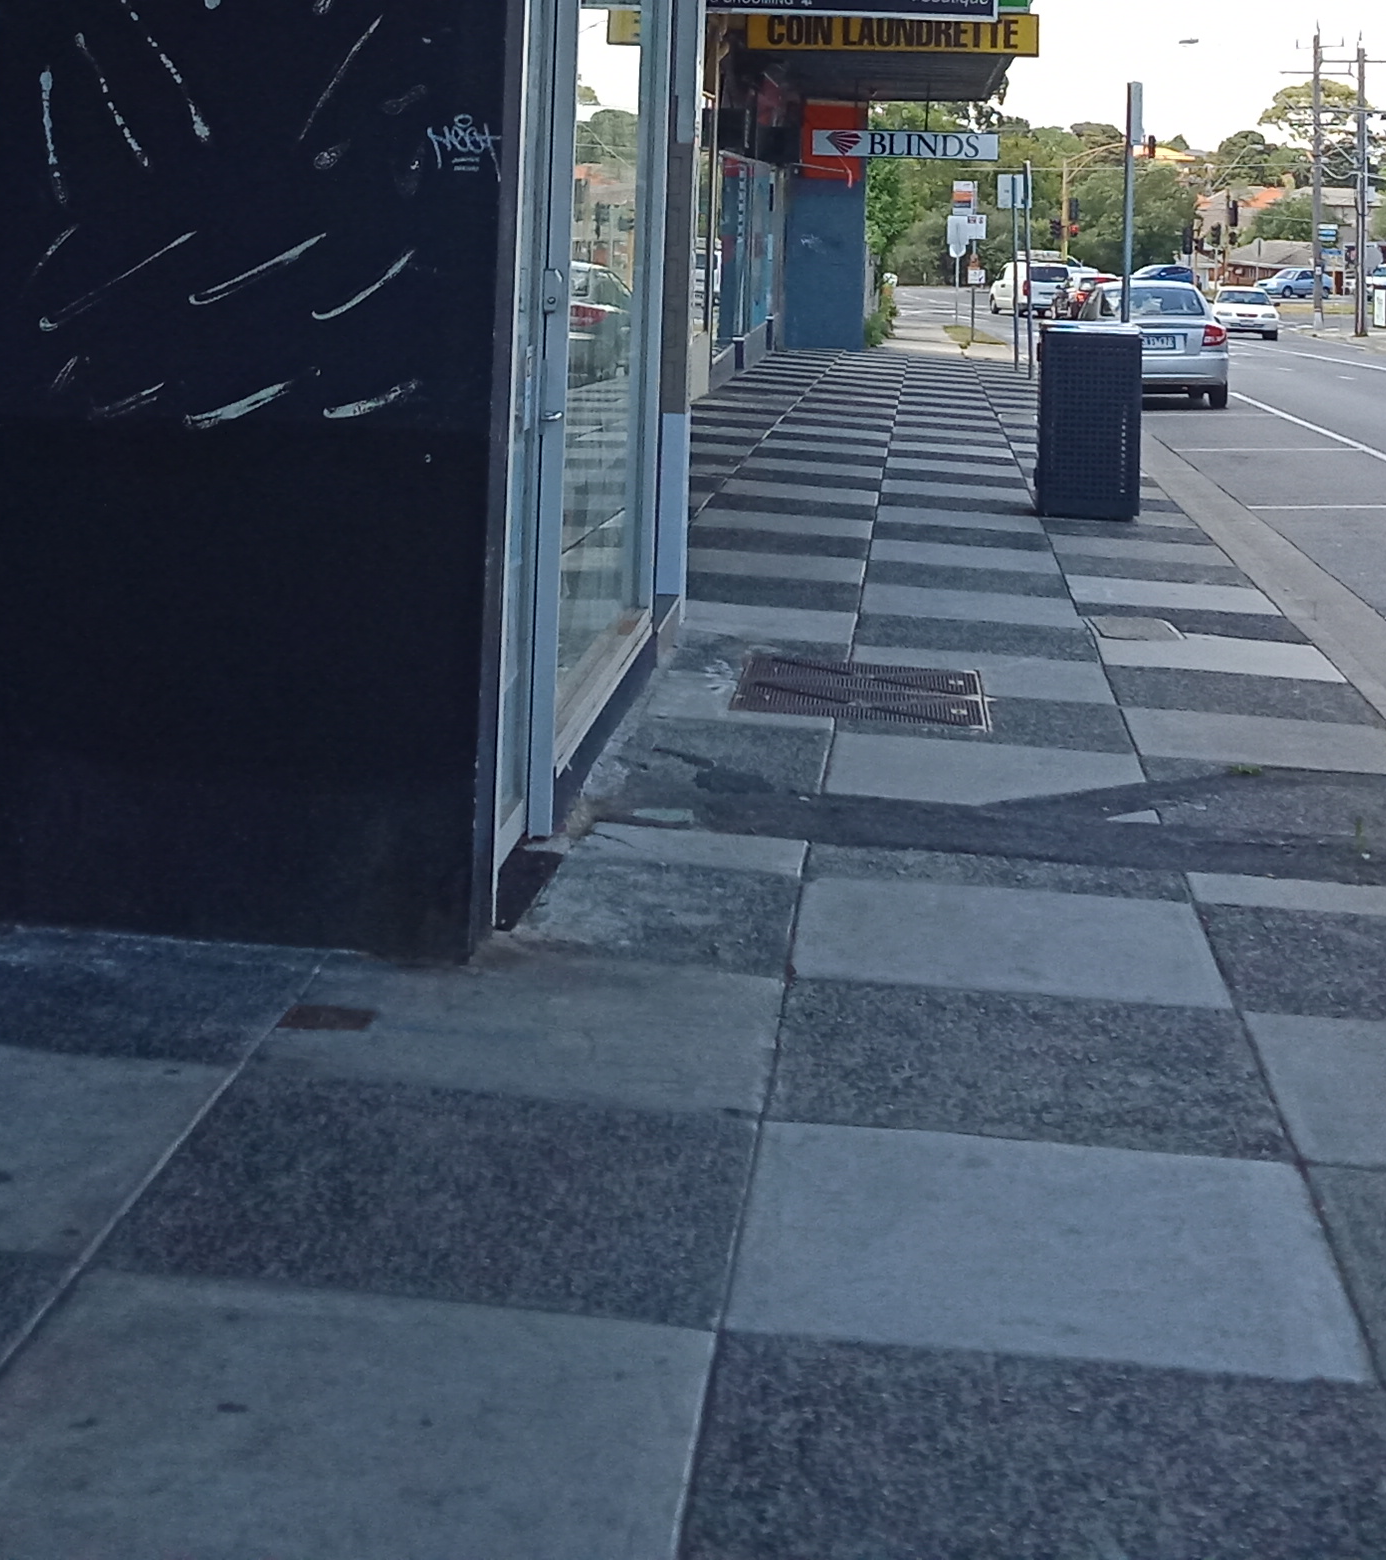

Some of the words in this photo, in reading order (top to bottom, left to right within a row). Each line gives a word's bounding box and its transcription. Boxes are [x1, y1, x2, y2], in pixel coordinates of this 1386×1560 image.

[767, 15, 832, 46] COIN
[842, 16, 1019, 50] LAUNDRETTE
[869, 132, 980, 158] BLINDS
